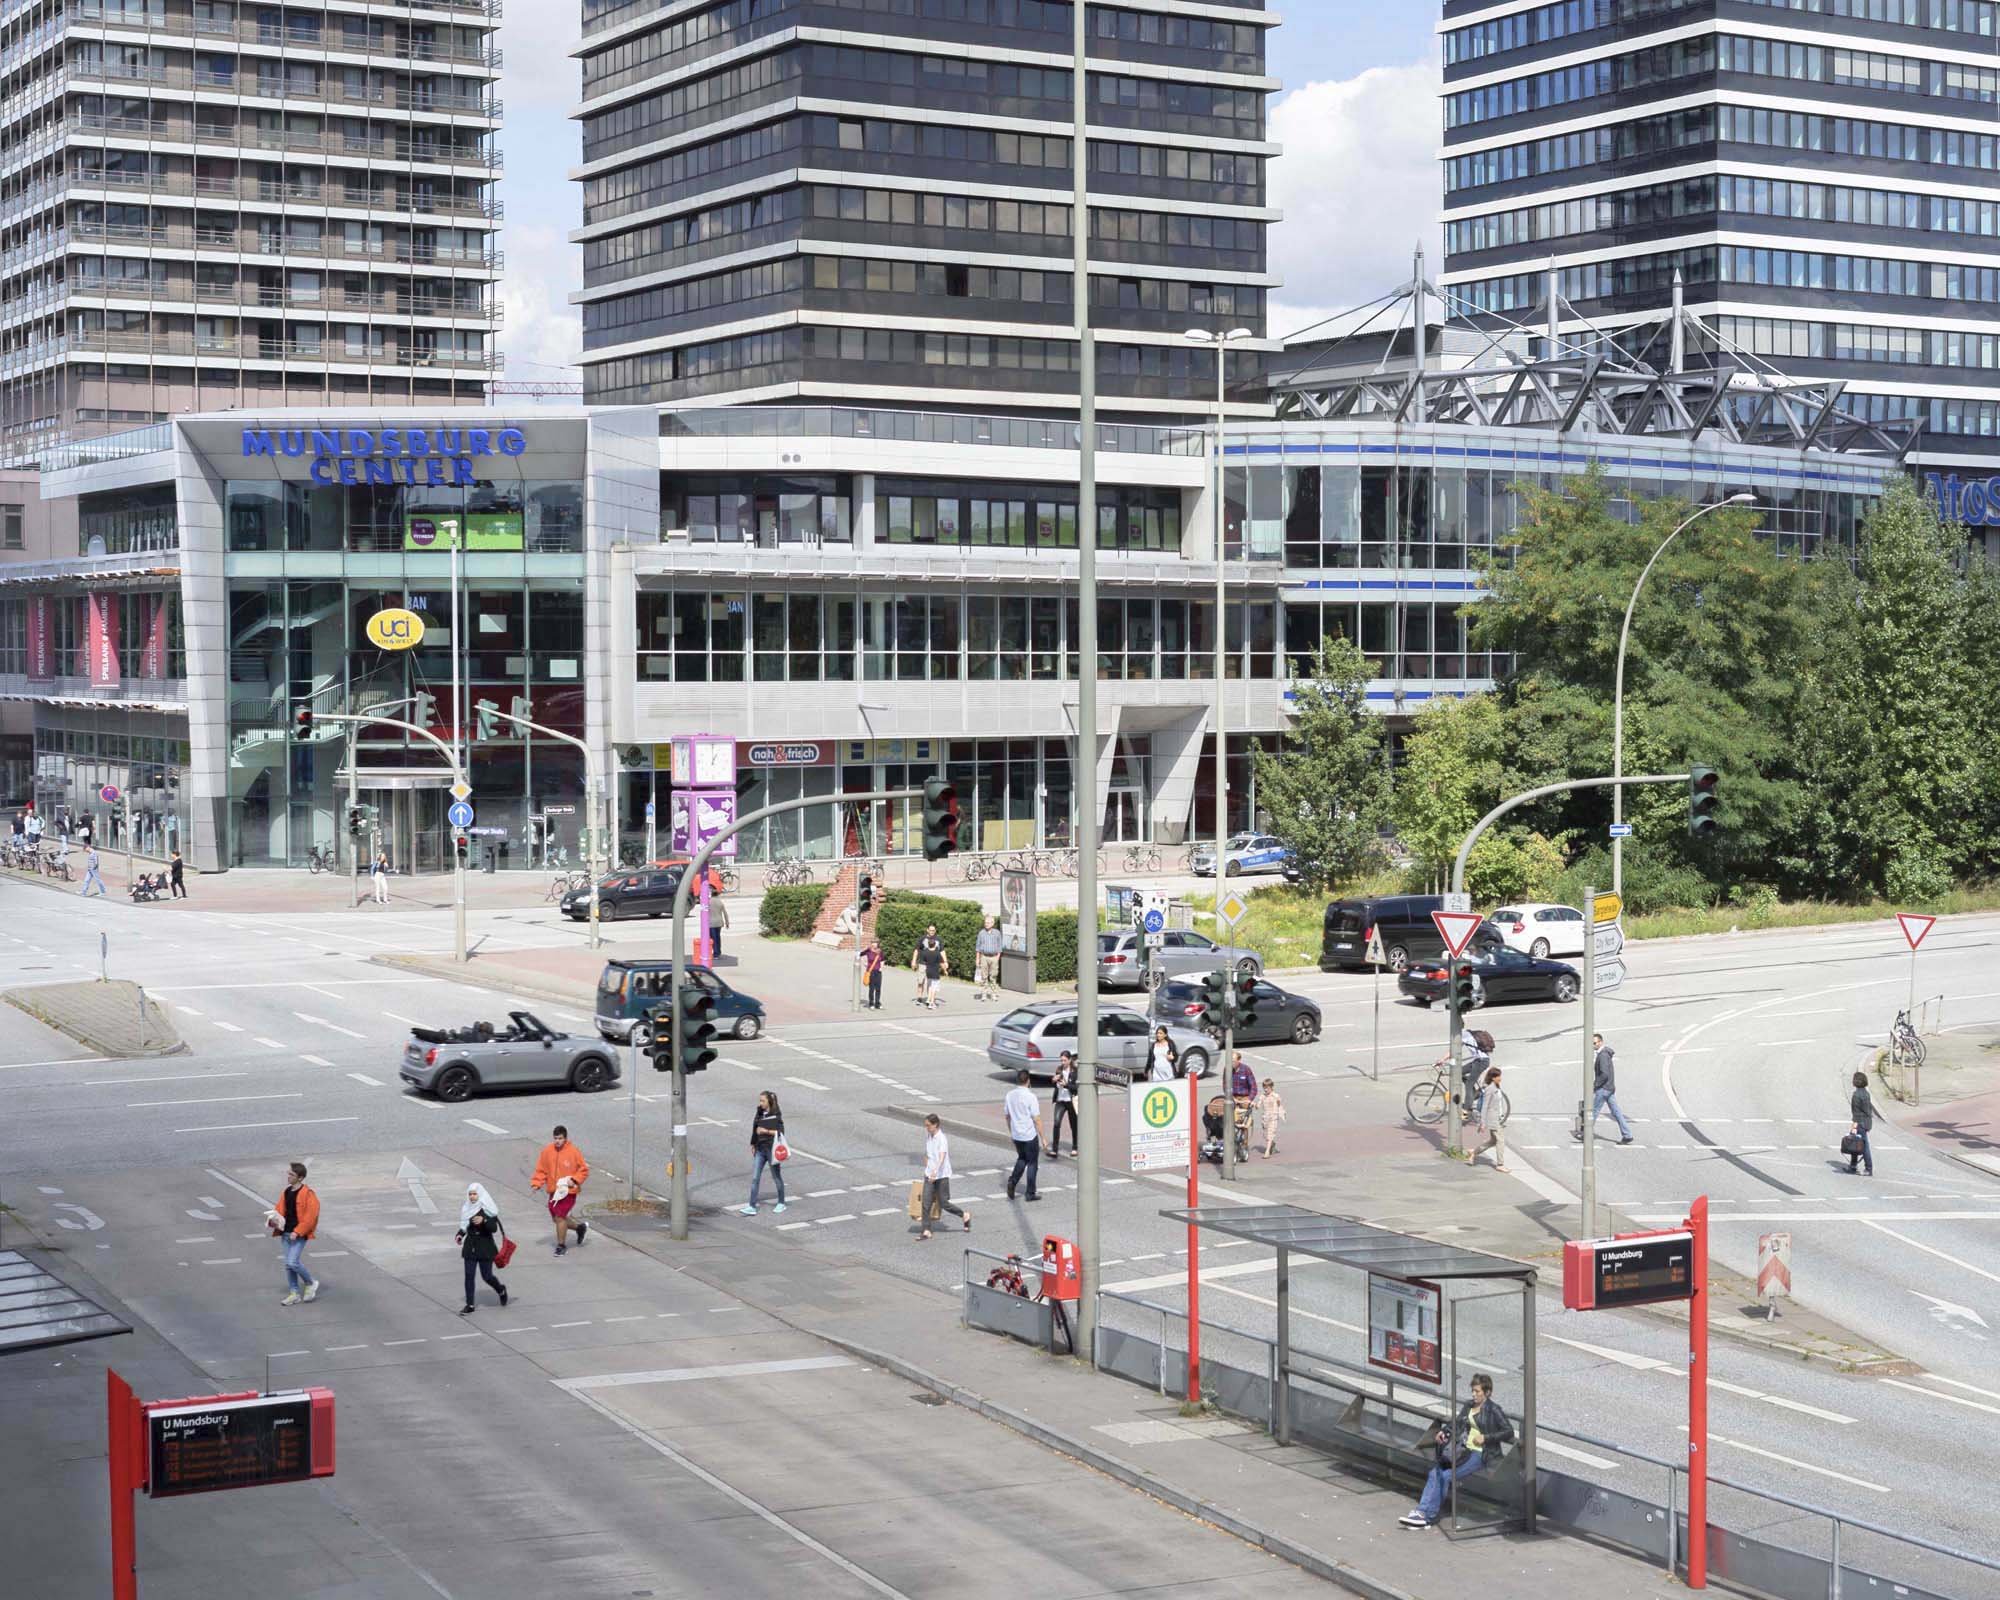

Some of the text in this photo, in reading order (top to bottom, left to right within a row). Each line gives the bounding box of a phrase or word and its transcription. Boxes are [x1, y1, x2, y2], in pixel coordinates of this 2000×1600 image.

[242, 428, 528, 457] MUNDSBURG
[310, 457, 477, 486] CENTER
[1596, 969, 1617, 983] Barmbek
[1152, 1096, 1168, 1119] H
[1602, 1250, 1643, 1261] U Mundsburg
[163, 1414, 229, 1429] U Mundsburg
